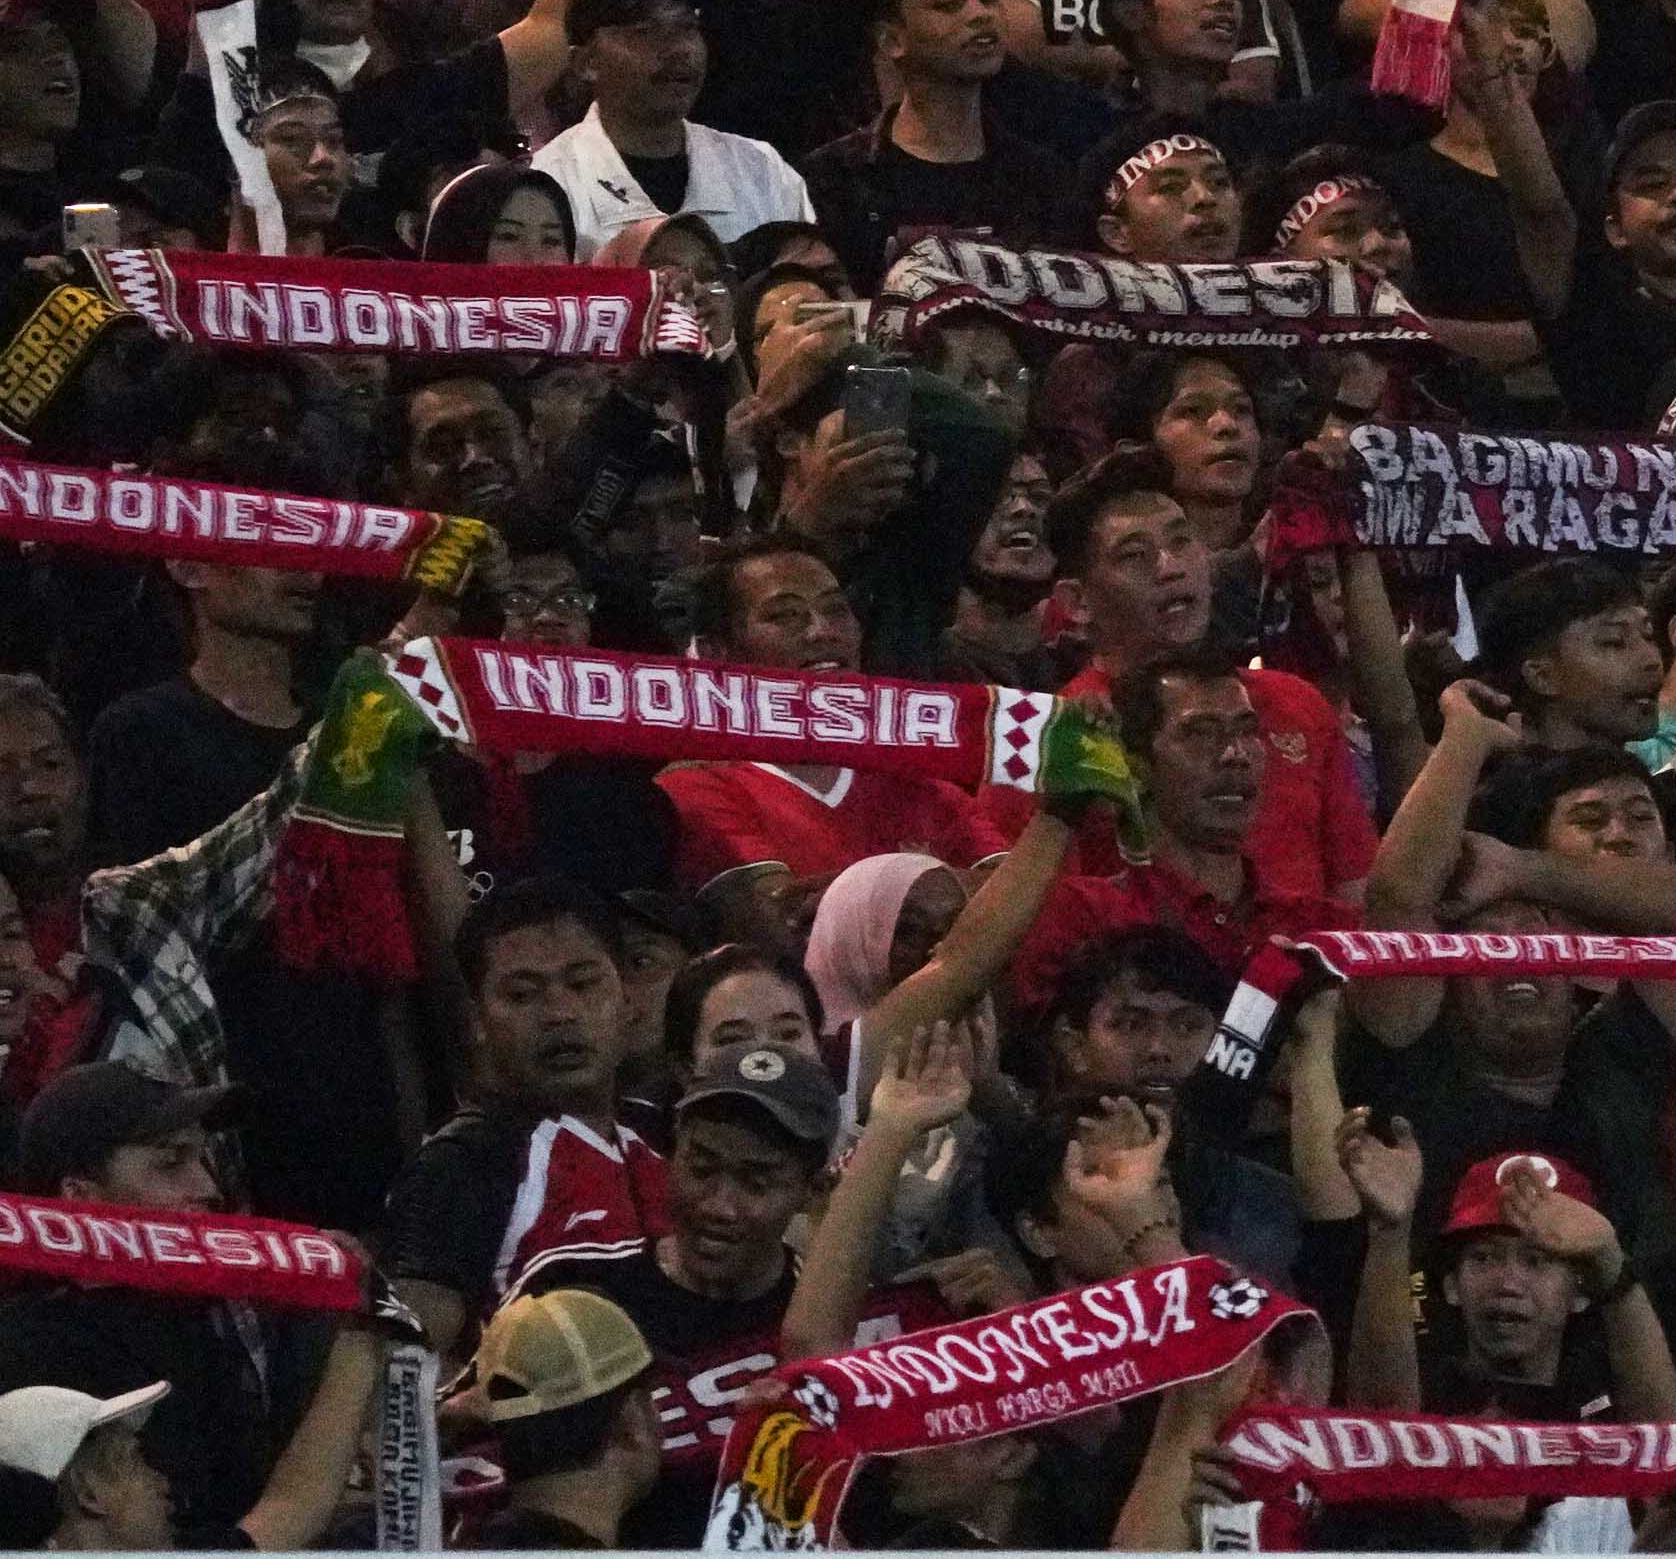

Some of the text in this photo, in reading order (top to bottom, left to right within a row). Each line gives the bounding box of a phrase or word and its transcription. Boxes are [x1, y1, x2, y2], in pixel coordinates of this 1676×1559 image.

[196, 279, 634, 356] INDONESIA
[1352, 425, 1620, 489] BAGIMU
[474, 648, 961, 749] INDONESIA
[826, 1265, 1198, 1409] INDONESIA
